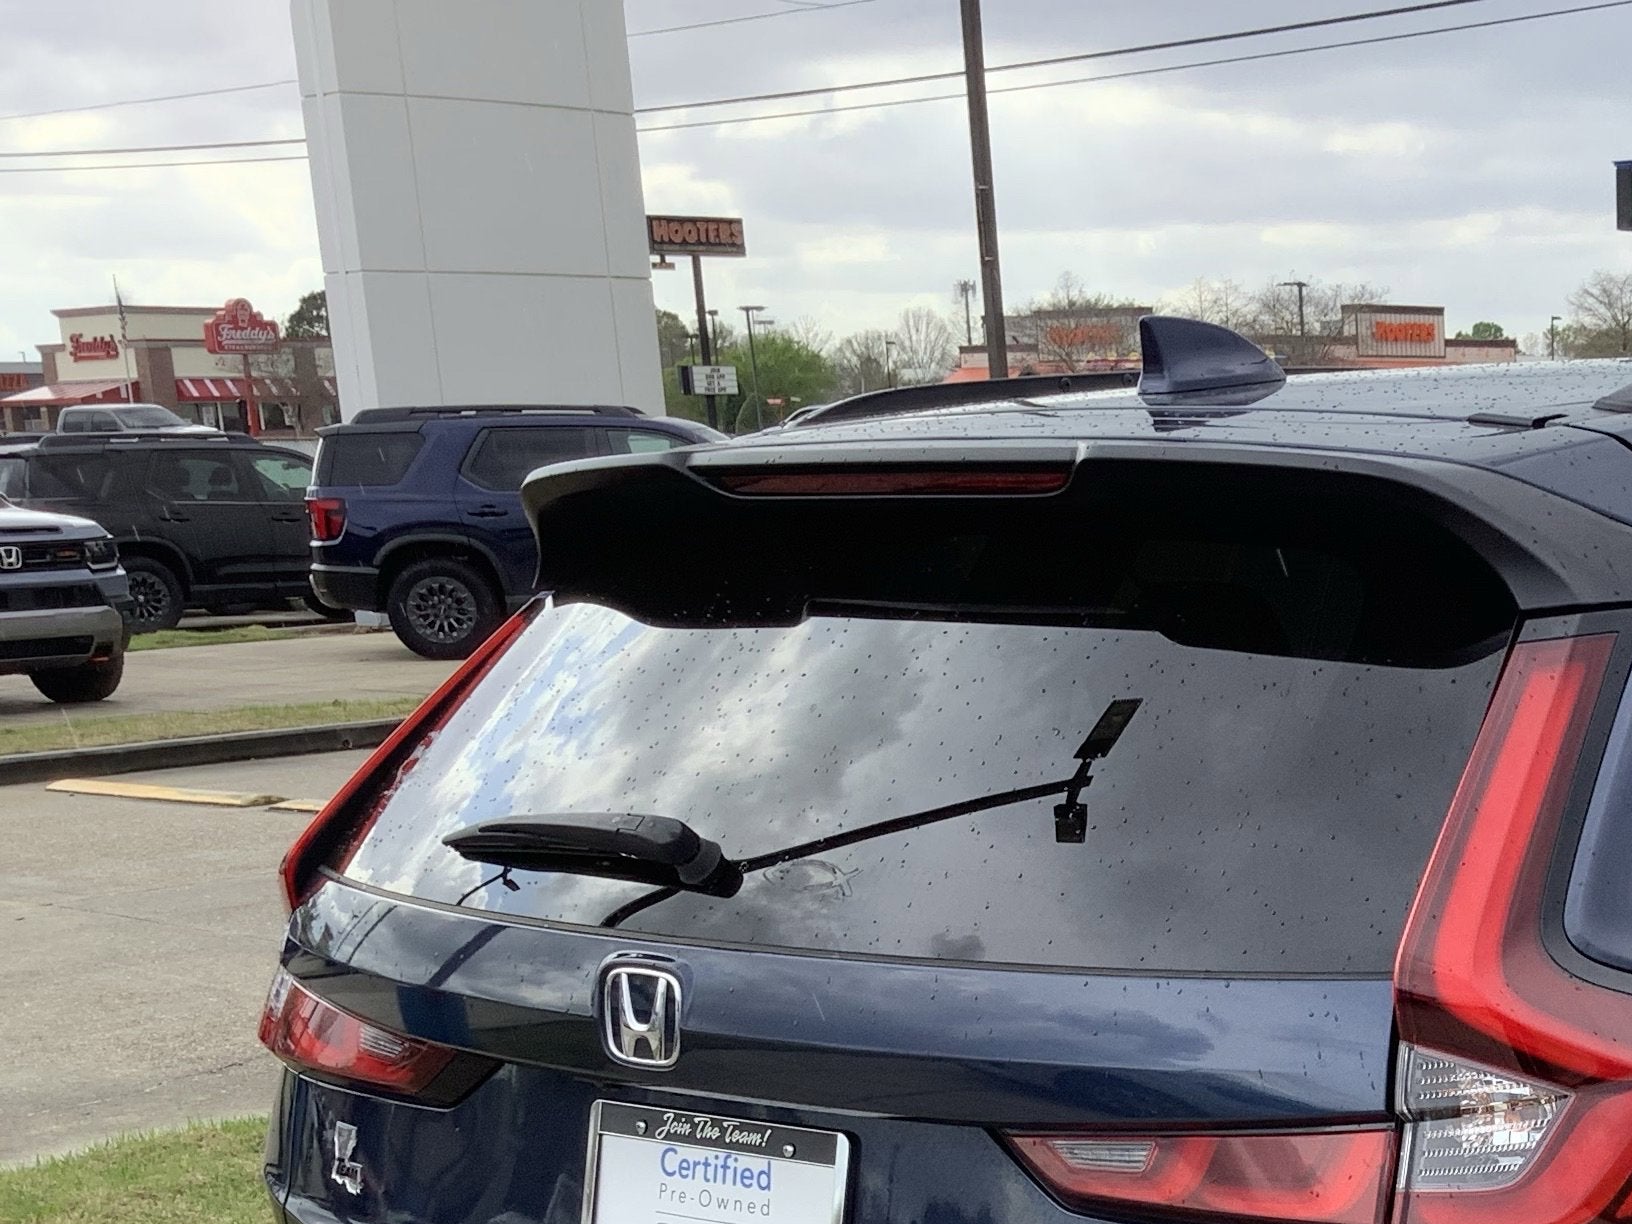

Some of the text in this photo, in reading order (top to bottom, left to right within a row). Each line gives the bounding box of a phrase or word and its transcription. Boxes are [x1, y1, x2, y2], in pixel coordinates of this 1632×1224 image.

[652, 219, 742, 245] HOOTERS
[217, 324, 275, 344] Freddy's
[655, 1112, 772, 1148] Join The Team!
[660, 1147, 772, 1192] Certified
[658, 1182, 770, 1217] Pre-Owned
